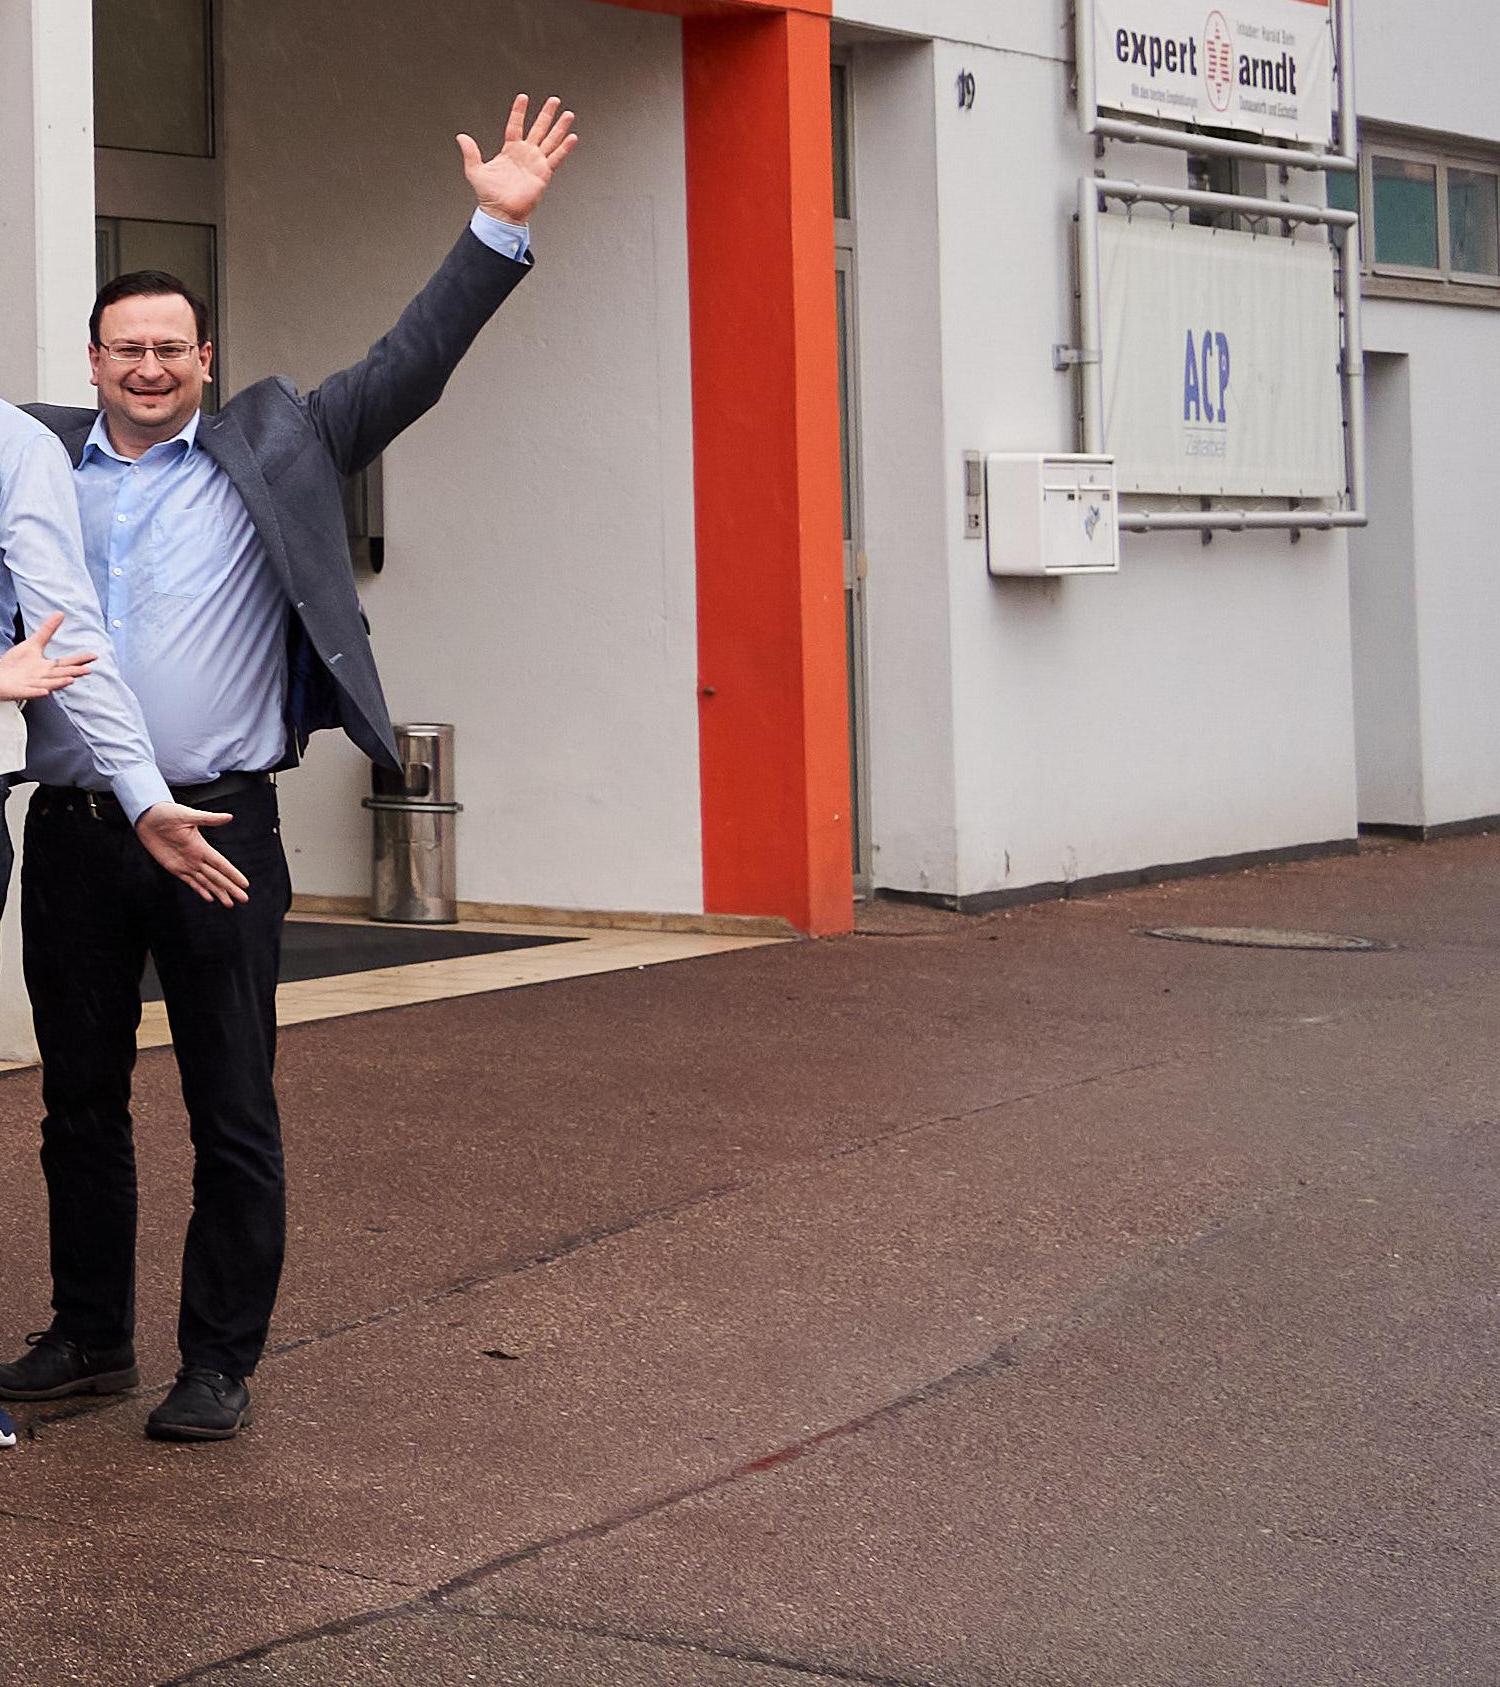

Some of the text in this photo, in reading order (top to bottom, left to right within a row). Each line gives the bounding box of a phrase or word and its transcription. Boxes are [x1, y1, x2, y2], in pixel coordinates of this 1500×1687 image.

[1115, 27, 1297, 96] expert arndt
[1183, 328, 1231, 424] ACP
